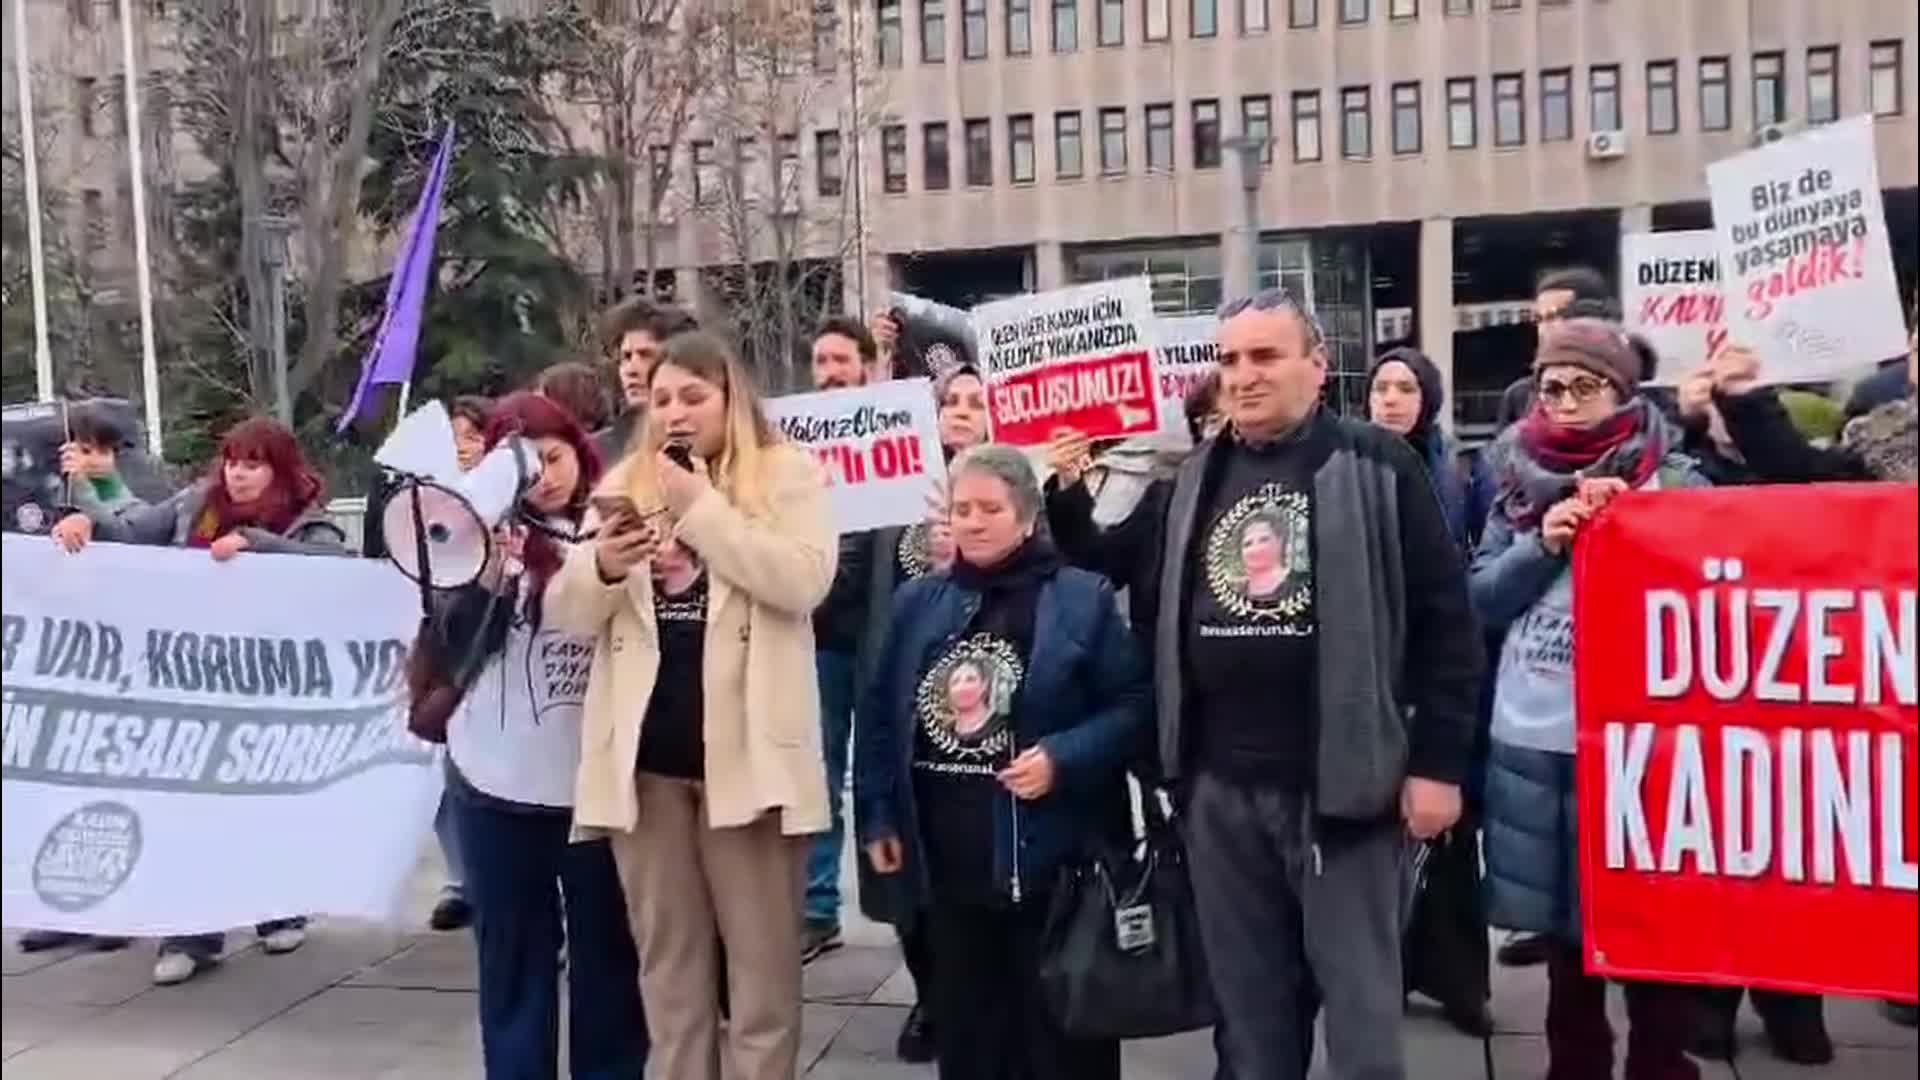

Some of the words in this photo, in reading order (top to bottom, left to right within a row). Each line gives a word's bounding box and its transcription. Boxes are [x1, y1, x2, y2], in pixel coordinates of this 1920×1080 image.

[1752, 180, 1792, 211] Biz
[1798, 168, 1833, 195] de
[1732, 221, 1759, 244] bu
[1735, 213, 1867, 275] yaşamaya
[1020, 314, 1046, 338] HER
[1047, 306, 1091, 332] KADIN
[1047, 323, 1138, 358] YAKANIZDA
[872, 434, 923, 479] Ol!
[1645, 556, 1918, 705] DÜZEN
[145, 628, 333, 699] KORUMA
[345, 638, 408, 695] YO
[46, 708, 221, 782] HESABI
[1604, 721, 1918, 890] KADINL
